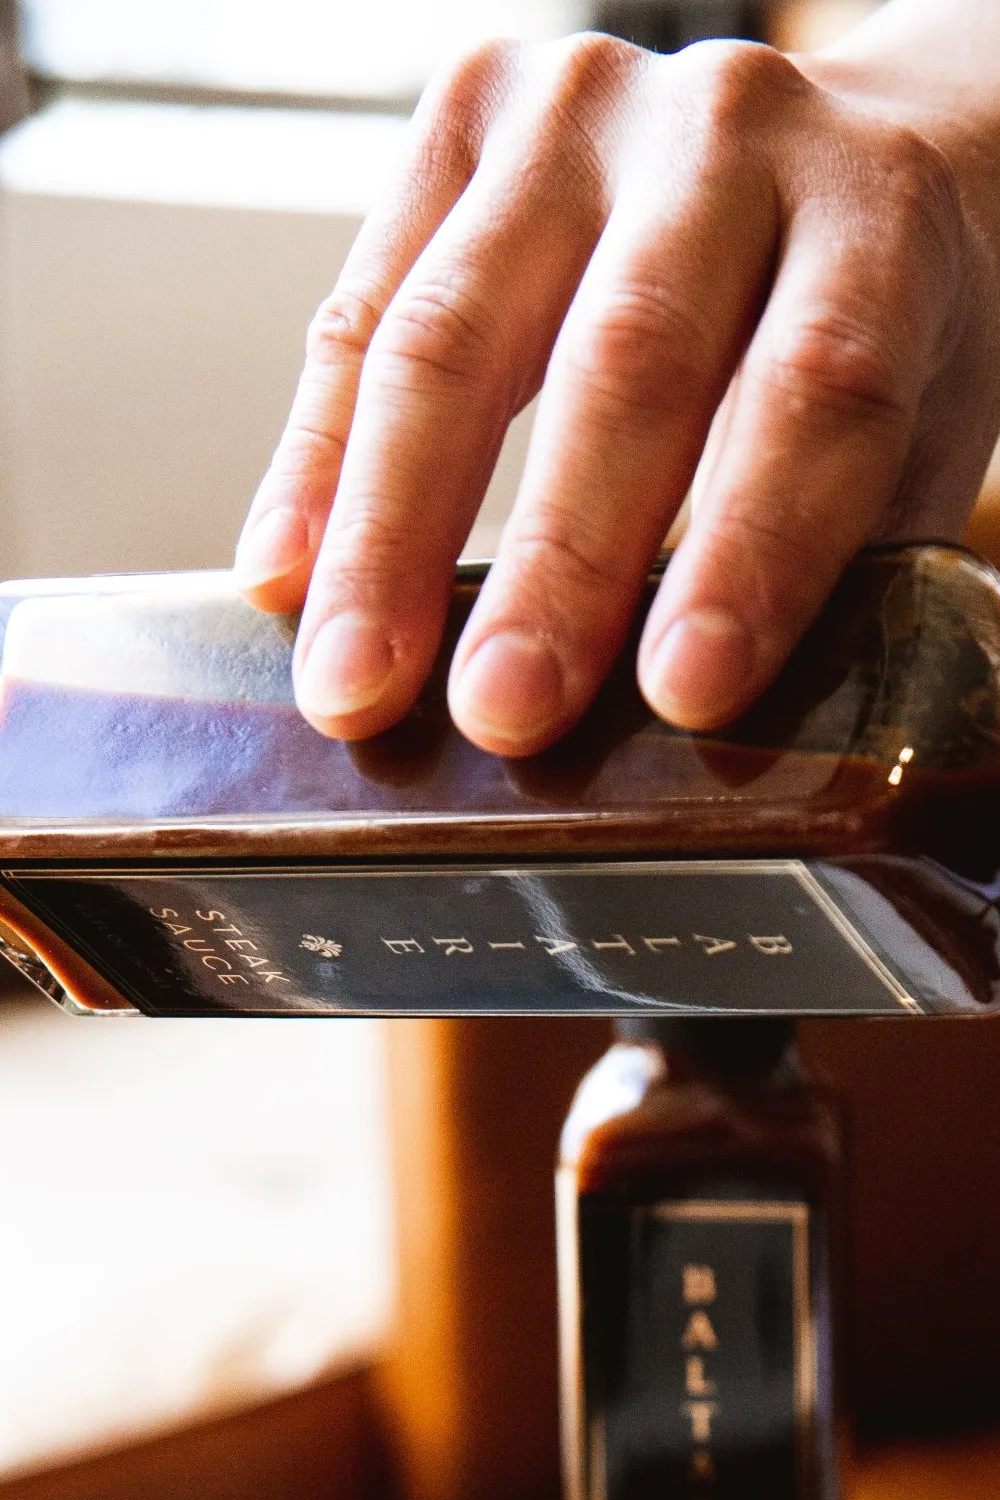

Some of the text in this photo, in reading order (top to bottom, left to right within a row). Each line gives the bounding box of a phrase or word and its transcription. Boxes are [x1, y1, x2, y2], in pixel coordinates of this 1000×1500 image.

[149, 907, 250, 986] SAUCE
[195, 909, 291, 983] STEAK
[379, 933, 794, 956] BALTAIRE
